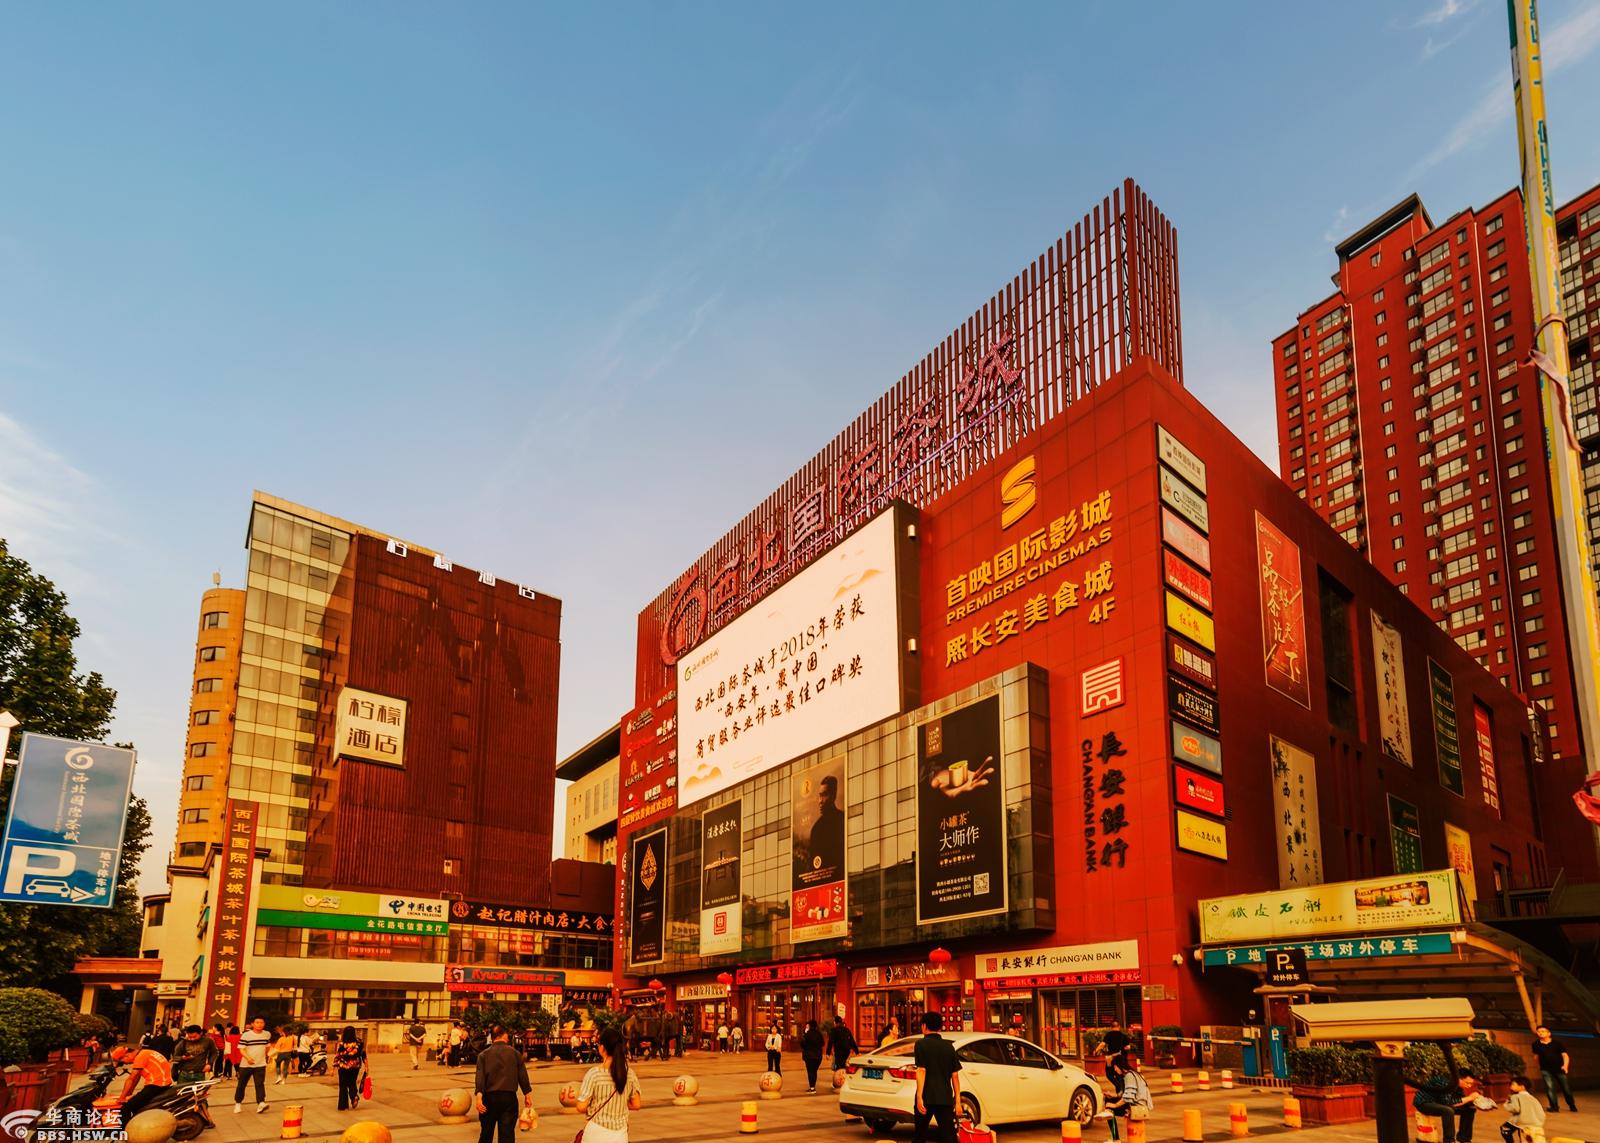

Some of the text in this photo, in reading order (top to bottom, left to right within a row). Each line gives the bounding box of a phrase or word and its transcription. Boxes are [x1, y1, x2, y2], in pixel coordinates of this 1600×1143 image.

[946, 489, 1112, 607] 首映国际影城
[946, 527, 1112, 625] PREMIERE CINEMAS
[1088, 597, 1115, 624] 4F
[694, 593, 866, 713] 西北国际茶城于2018年荣获
[348, 697, 401, 727] 柠檬
[695, 654, 864, 760] 商贸服务业评选最佳口碑奖
[346, 726, 399, 755] 酒店
[939, 825, 980, 851] 大师作
[1084, 826, 1097, 873] BANK
[4, 845, 77, 895] P
[210, 808, 255, 1020] 西北国际茶城茶叶茶具批发中心
[407, 901, 443, 914] 中国电信
[477, 906, 614, 932] 赵记腊汁肉店·大食
[366, 919, 443, 933] 金花路电信营业厅
[1050, 951, 1122, 965] CHANG'AN BANK
[1248, 938, 1419, 962] 地车场对外停车
[1276, 954, 1291, 971] P
[1272, 972, 1300, 982] 对外停车
